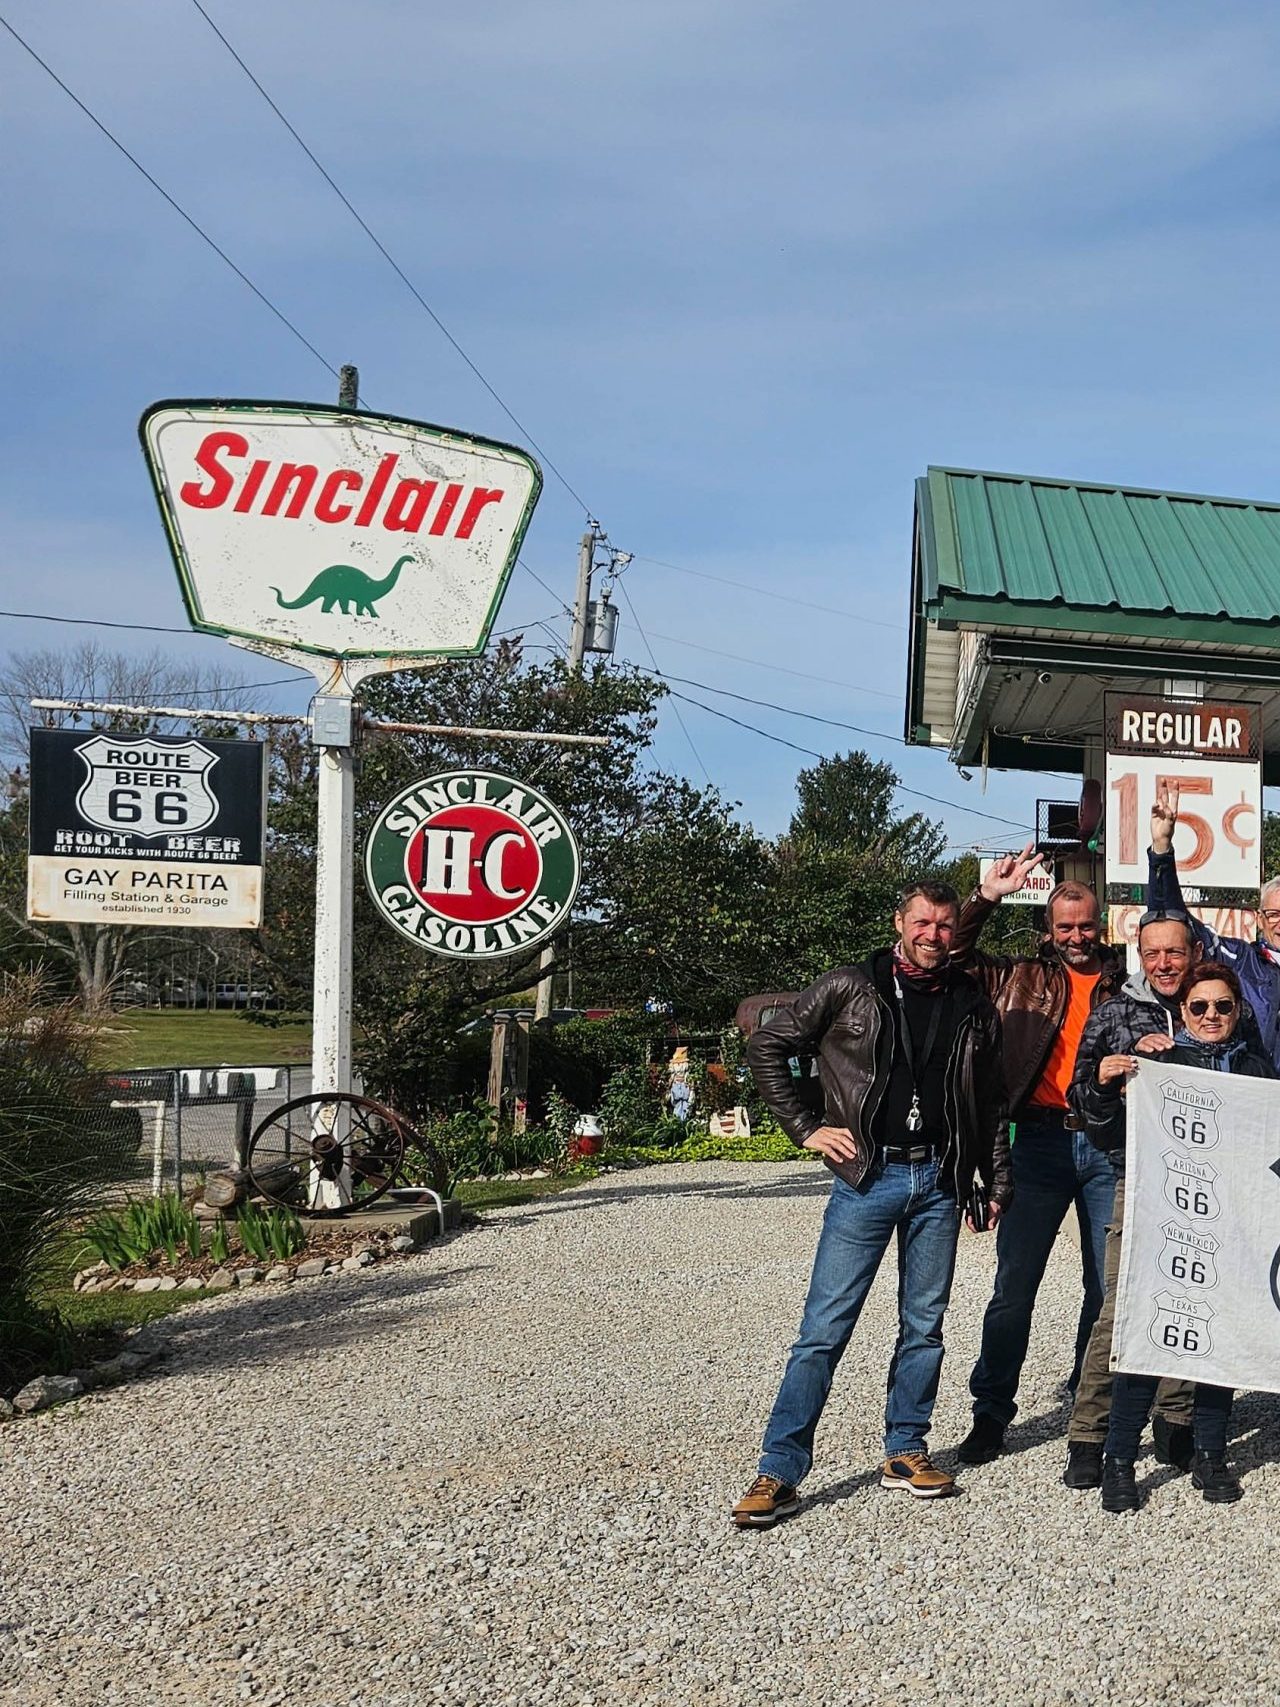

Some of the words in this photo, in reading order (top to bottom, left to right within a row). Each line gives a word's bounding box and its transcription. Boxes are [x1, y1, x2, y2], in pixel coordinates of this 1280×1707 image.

[180, 431, 504, 540] Sinclair
[1122, 710, 1242, 749] REGULAR
[107, 750, 190, 768] ROUTE
[115, 772, 181, 788] BEER
[108, 789, 188, 825] 66
[385, 777, 562, 847] SINCLAIR
[54, 845, 71, 853] GET
[75, 846, 101, 854] YOUR
[104, 847, 133, 856] KICKS
[137, 849, 161, 857] WITH
[164, 850, 194, 859] ROUTE
[56, 829, 132, 847] ROOT
[167, 835, 241, 852] BEER
[422, 828, 526, 899] H-C
[64, 868, 120, 886] GAY
[131, 871, 228, 891] PARITA
[64, 890, 106, 902] Filling
[111, 891, 159, 902] Station
[164, 894, 174, 903] &
[180, 894, 228, 907] Garage
[102, 904, 163, 913] established
[167, 906, 191, 914] 1930
[382, 885, 561, 952] GASOLINE
[1167, 1088, 1215, 1108] CALIFORNIA
[1172, 1116, 1206, 1144] 66
[1173, 1160, 1206, 1177] ARIZONA
[1175, 1187, 1208, 1215] 66
[1167, 1227, 1184, 1240] NEW
[1187, 1234, 1214, 1251] MEXICO
[1172, 1256, 1205, 1284] 66
[1171, 1299, 1197, 1314] TEXAS
[1163, 1325, 1199, 1351] 66
